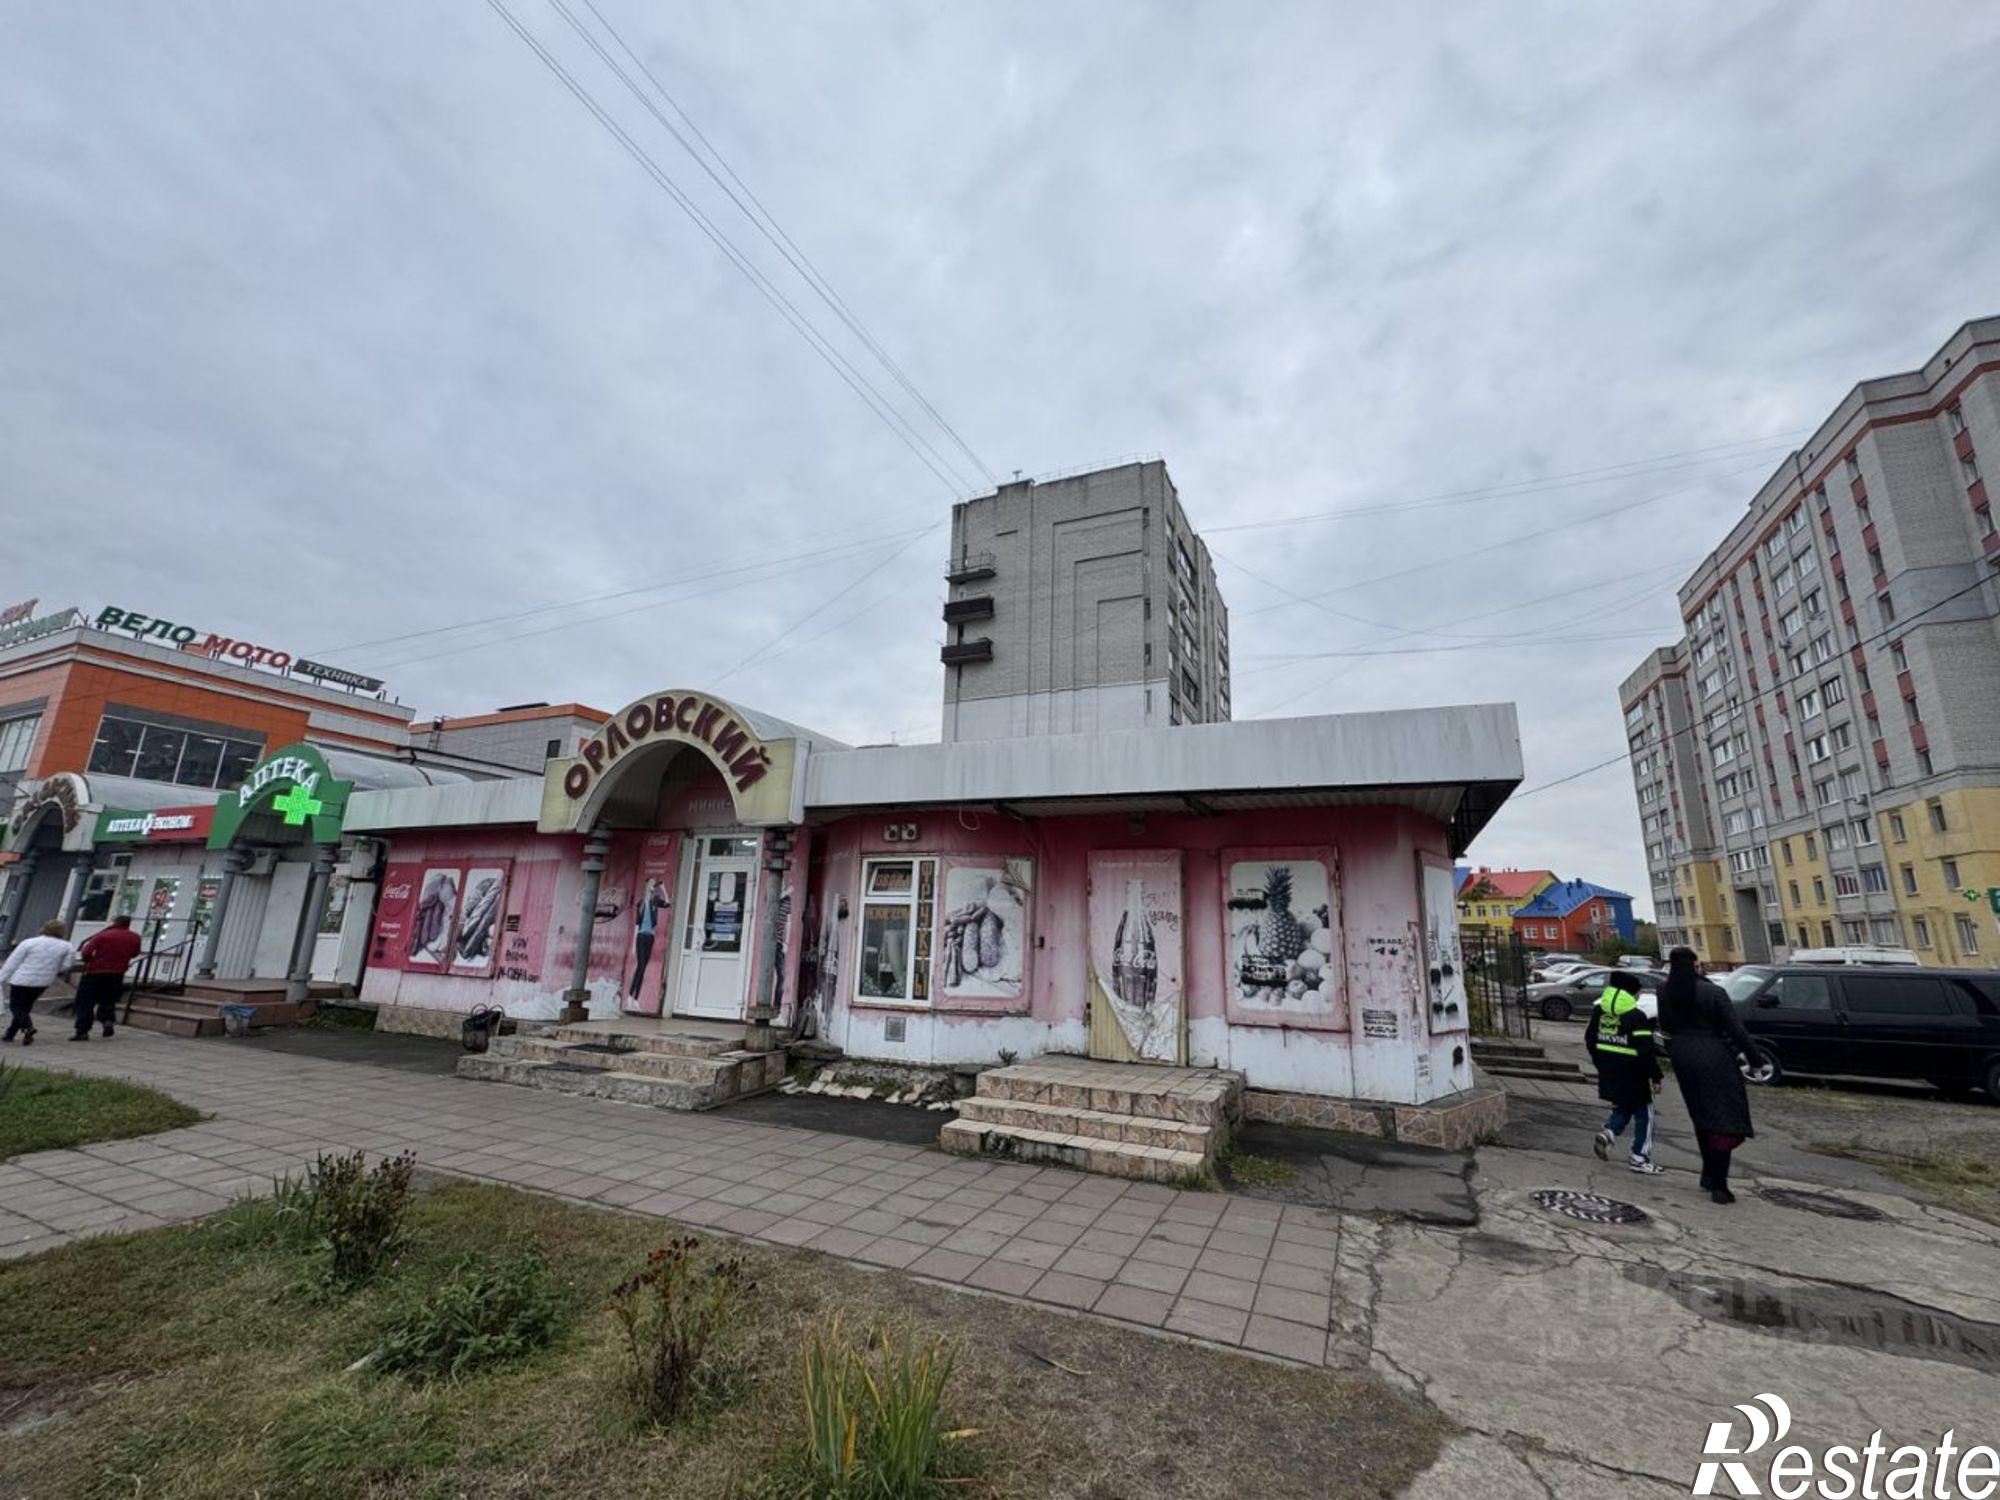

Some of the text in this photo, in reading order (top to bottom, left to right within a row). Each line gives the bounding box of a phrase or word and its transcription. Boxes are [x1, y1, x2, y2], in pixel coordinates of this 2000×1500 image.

[96, 605, 196, 644] ВЕЛО
[202, 633, 292, 669] МОТО
[304, 663, 369, 688] ТЕХНИКА
[564, 696, 772, 800] ОРЛОВСКИЙ
[239, 756, 320, 808] АПТЕКА
[913, 862, 934, 997] ФРУКТЫ
